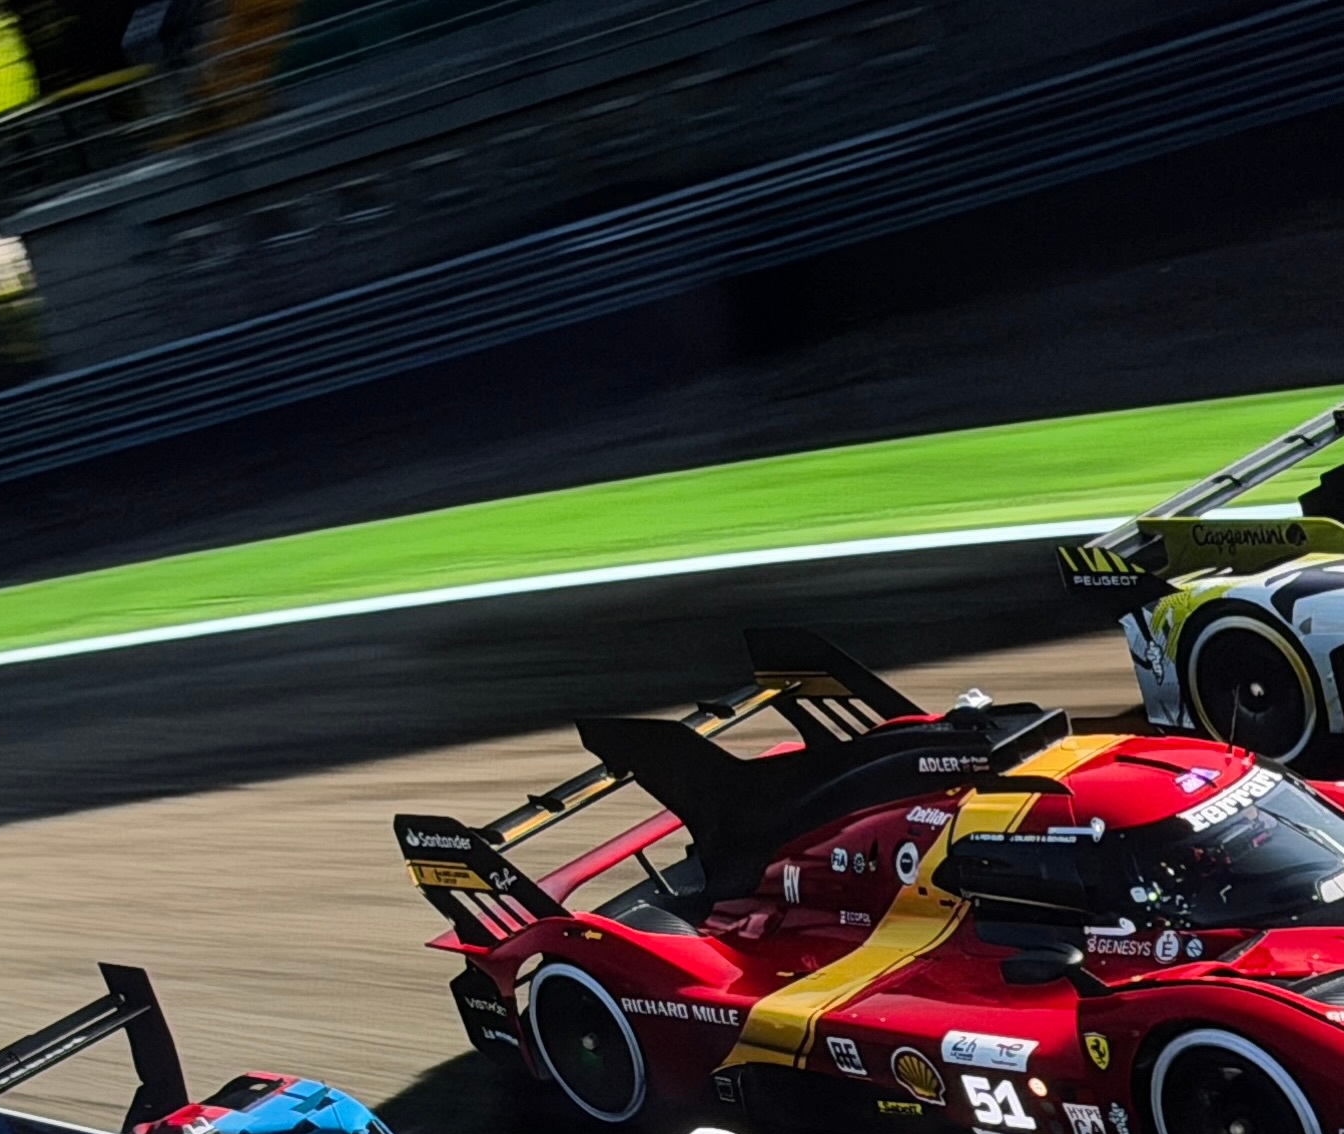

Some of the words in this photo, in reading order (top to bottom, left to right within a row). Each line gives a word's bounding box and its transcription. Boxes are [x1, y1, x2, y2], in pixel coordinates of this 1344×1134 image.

[1192, 523, 1285, 554] Capgemini
[1073, 574, 1138, 586] PEUGEOT
[918, 756, 961, 773] ADLER
[1176, 765, 1283, 832] Ferrari
[906, 805, 955, 826] Cetilar
[418, 832, 472, 850] Santander
[783, 864, 801, 904] HY
[1097, 939, 1153, 956] GENESYS
[620, 997, 689, 1020] RICHARD
[692, 1005, 740, 1026] MILLE
[960, 1074, 1037, 1131] 51
